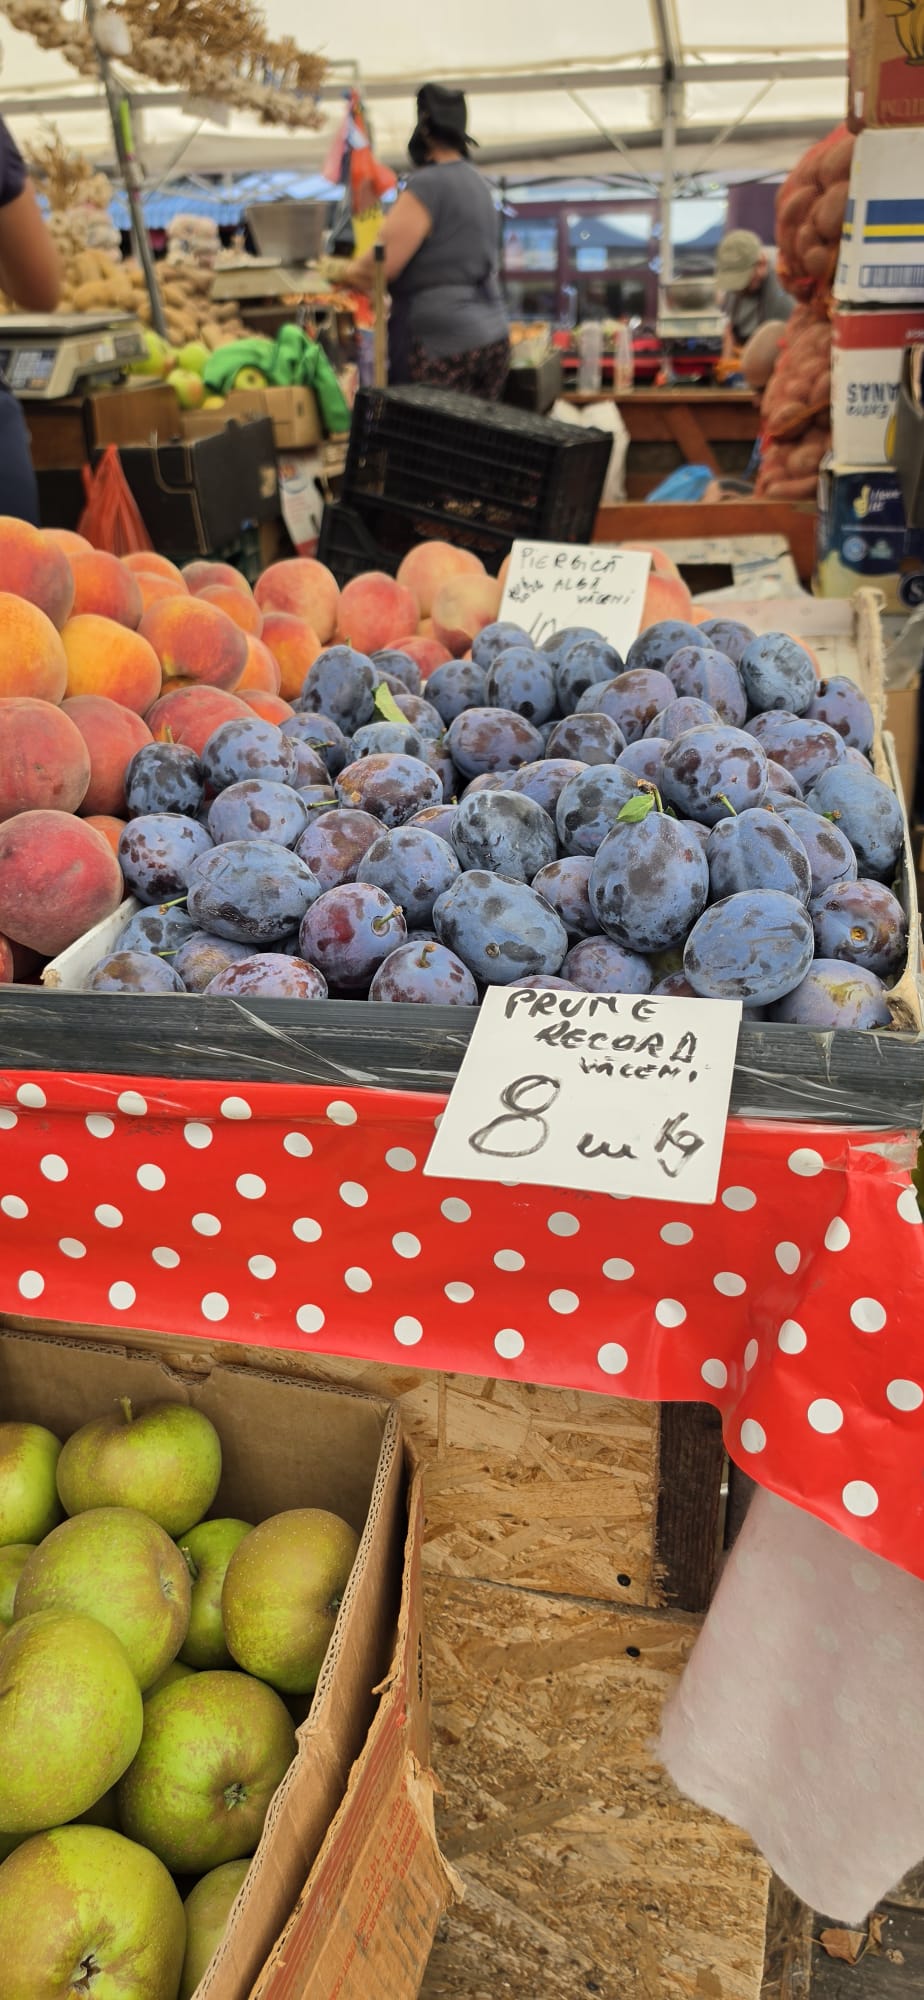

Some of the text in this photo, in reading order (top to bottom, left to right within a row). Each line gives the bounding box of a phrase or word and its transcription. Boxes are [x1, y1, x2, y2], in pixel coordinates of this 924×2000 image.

[504, 987, 657, 1022] PRUNE
[533, 1020, 699, 1063] RECORD
[468, 1073, 561, 1159] 8
